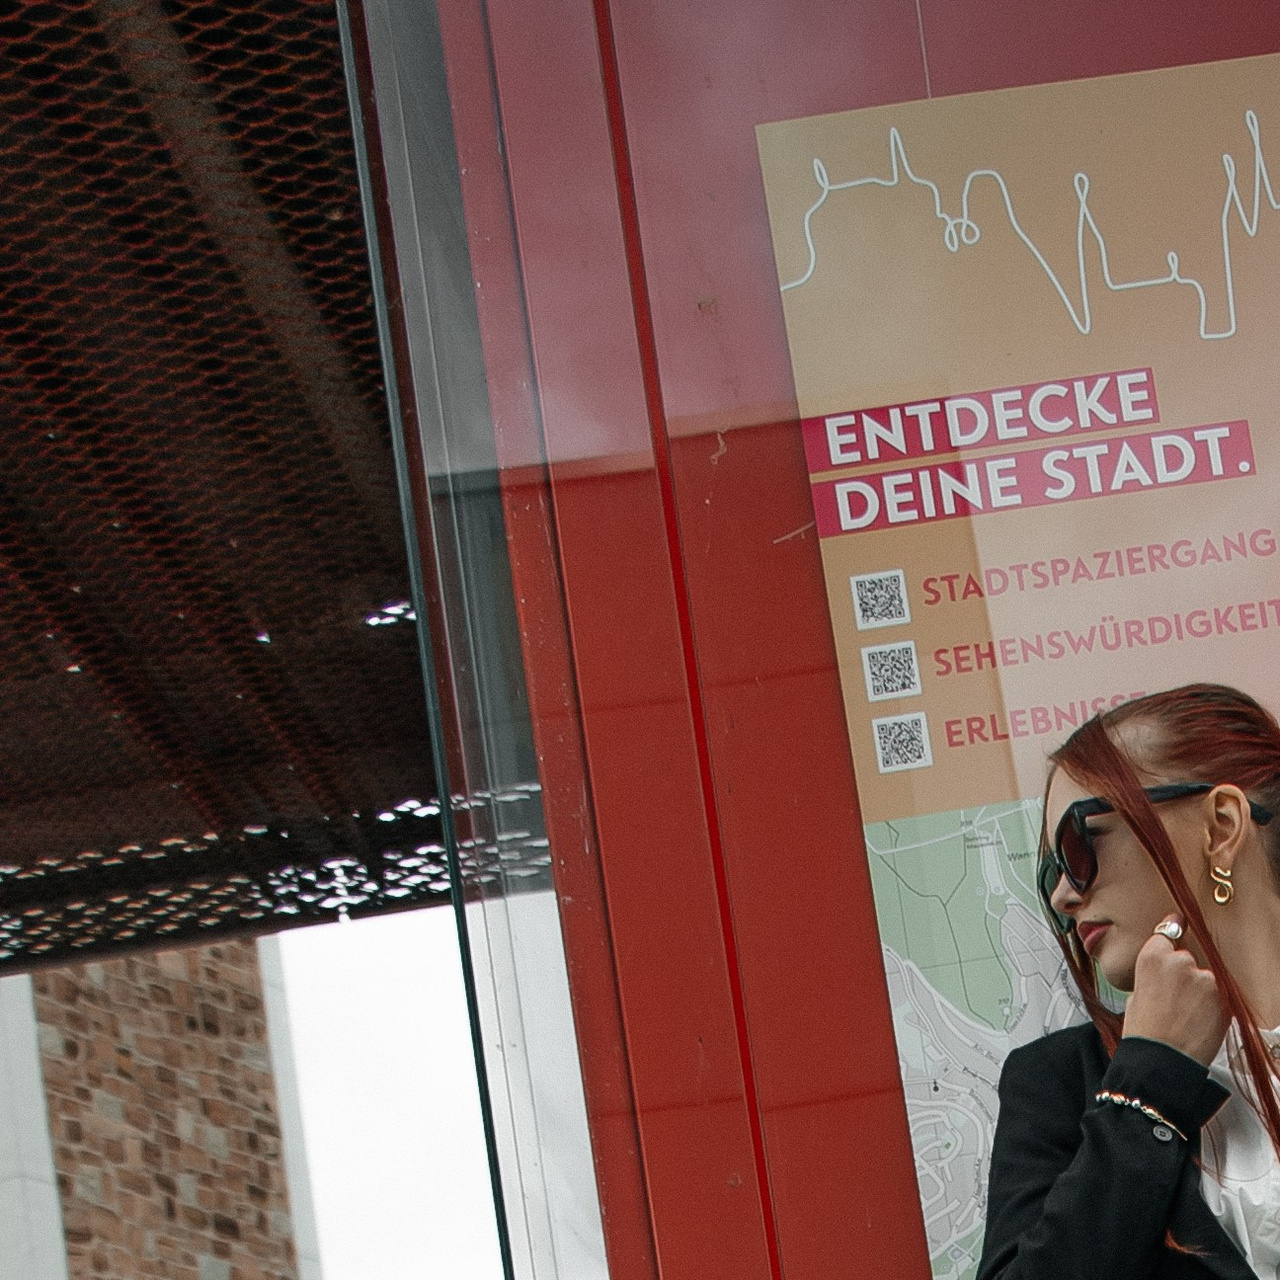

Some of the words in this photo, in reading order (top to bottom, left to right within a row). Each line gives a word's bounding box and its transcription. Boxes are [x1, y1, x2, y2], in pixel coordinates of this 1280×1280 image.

[824, 371, 1154, 466] ENTDECKE
[835, 457, 1022, 531] DEINE
[1042, 426, 1251, 500] STADT.
[922, 528, 1278, 607] STADTSPAZIERGANG
